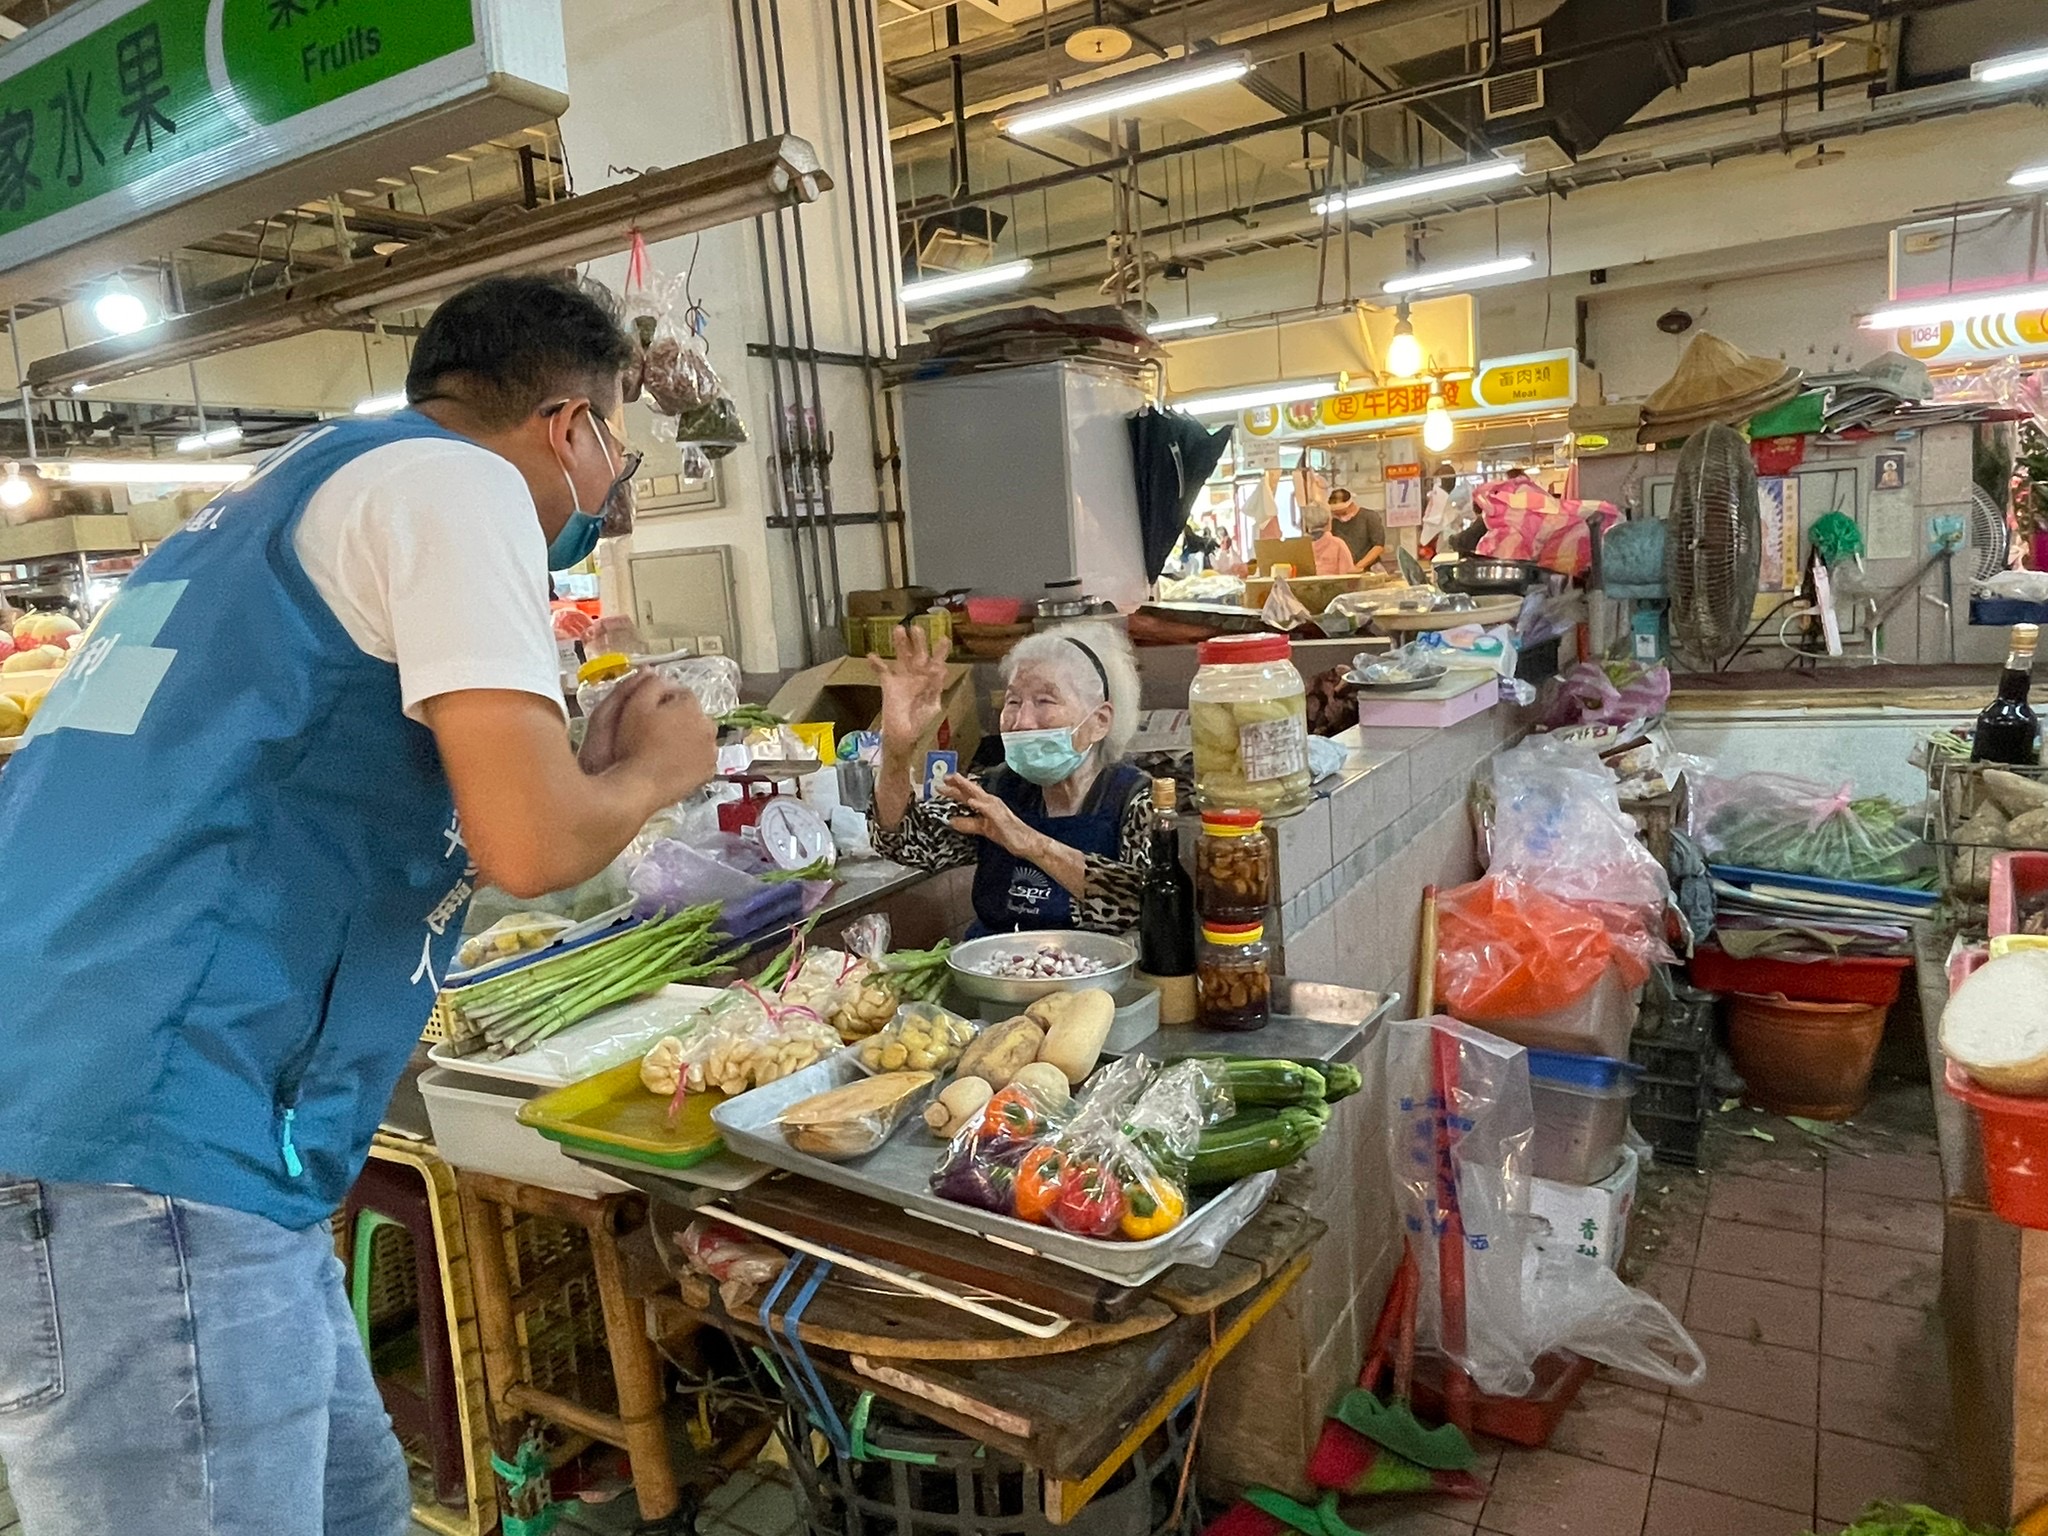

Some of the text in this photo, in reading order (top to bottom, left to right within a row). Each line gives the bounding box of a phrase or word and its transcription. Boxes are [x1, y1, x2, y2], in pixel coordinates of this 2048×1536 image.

[302, 26, 381, 83] Fruits
[1912, 326, 1940, 343] 1084
[1512, 389, 1537, 398] Meat
[1397, 480, 1409, 503] 7
